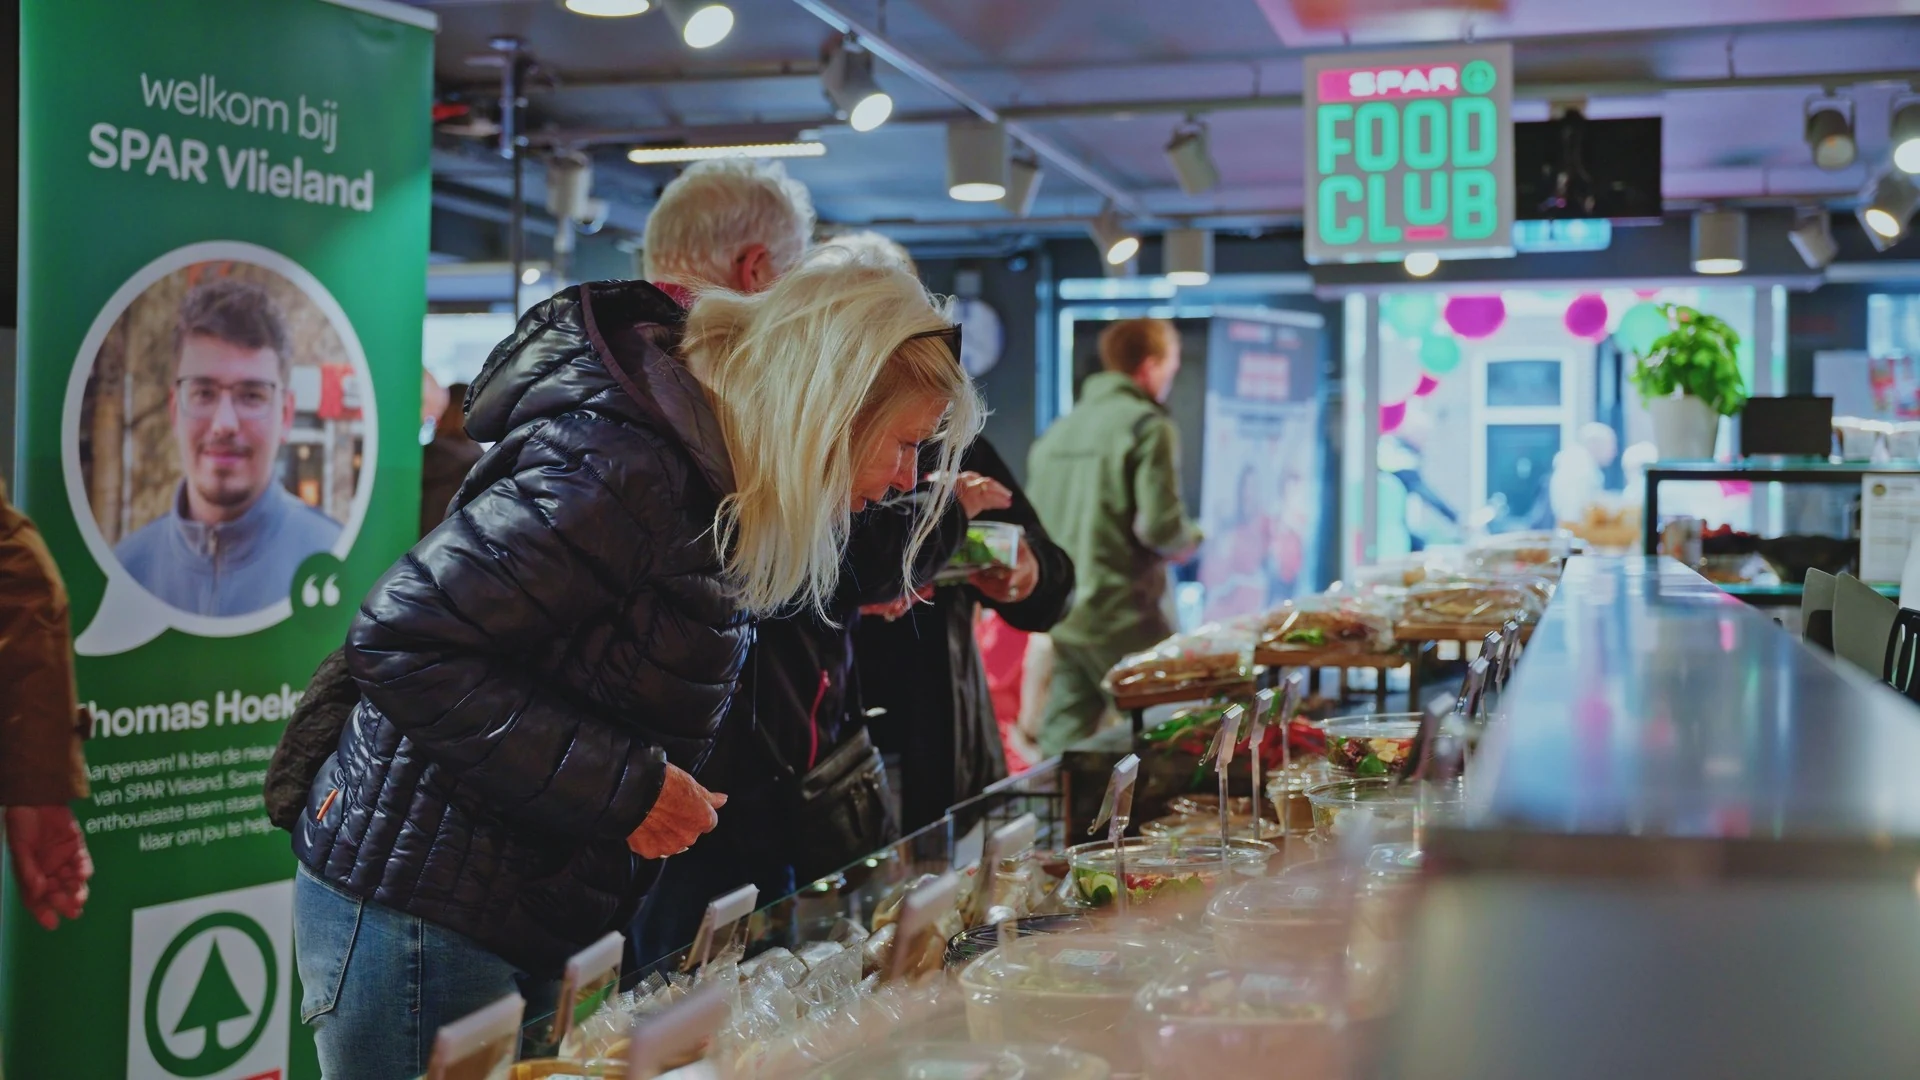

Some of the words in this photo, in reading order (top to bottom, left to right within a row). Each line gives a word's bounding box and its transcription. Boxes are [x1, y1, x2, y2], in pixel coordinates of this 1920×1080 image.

[1348, 66, 1458, 97] SPAR
[140, 73, 288, 135] welkom
[298, 95, 338, 153] bij
[1317, 96, 1497, 174] FOOD
[88, 123, 208, 183] SPAR
[218, 145, 374, 212] Vlieland
[1317, 169, 1497, 246] CLUB
[215, 683, 304, 726] Hoek
[192, 751, 220, 769] ben
[222, 746, 242, 763] de
[243, 743, 276, 761] nieu
[94, 788, 122, 807] van
[125, 780, 165, 803] SPAR
[227, 769, 267, 789] Same
[86, 804, 185, 834] enthousiaste
[186, 799, 224, 821] team
[139, 831, 174, 852] klaar
[177, 829, 201, 847] om
[201, 823, 226, 846] jou
[227, 820, 243, 838] te
